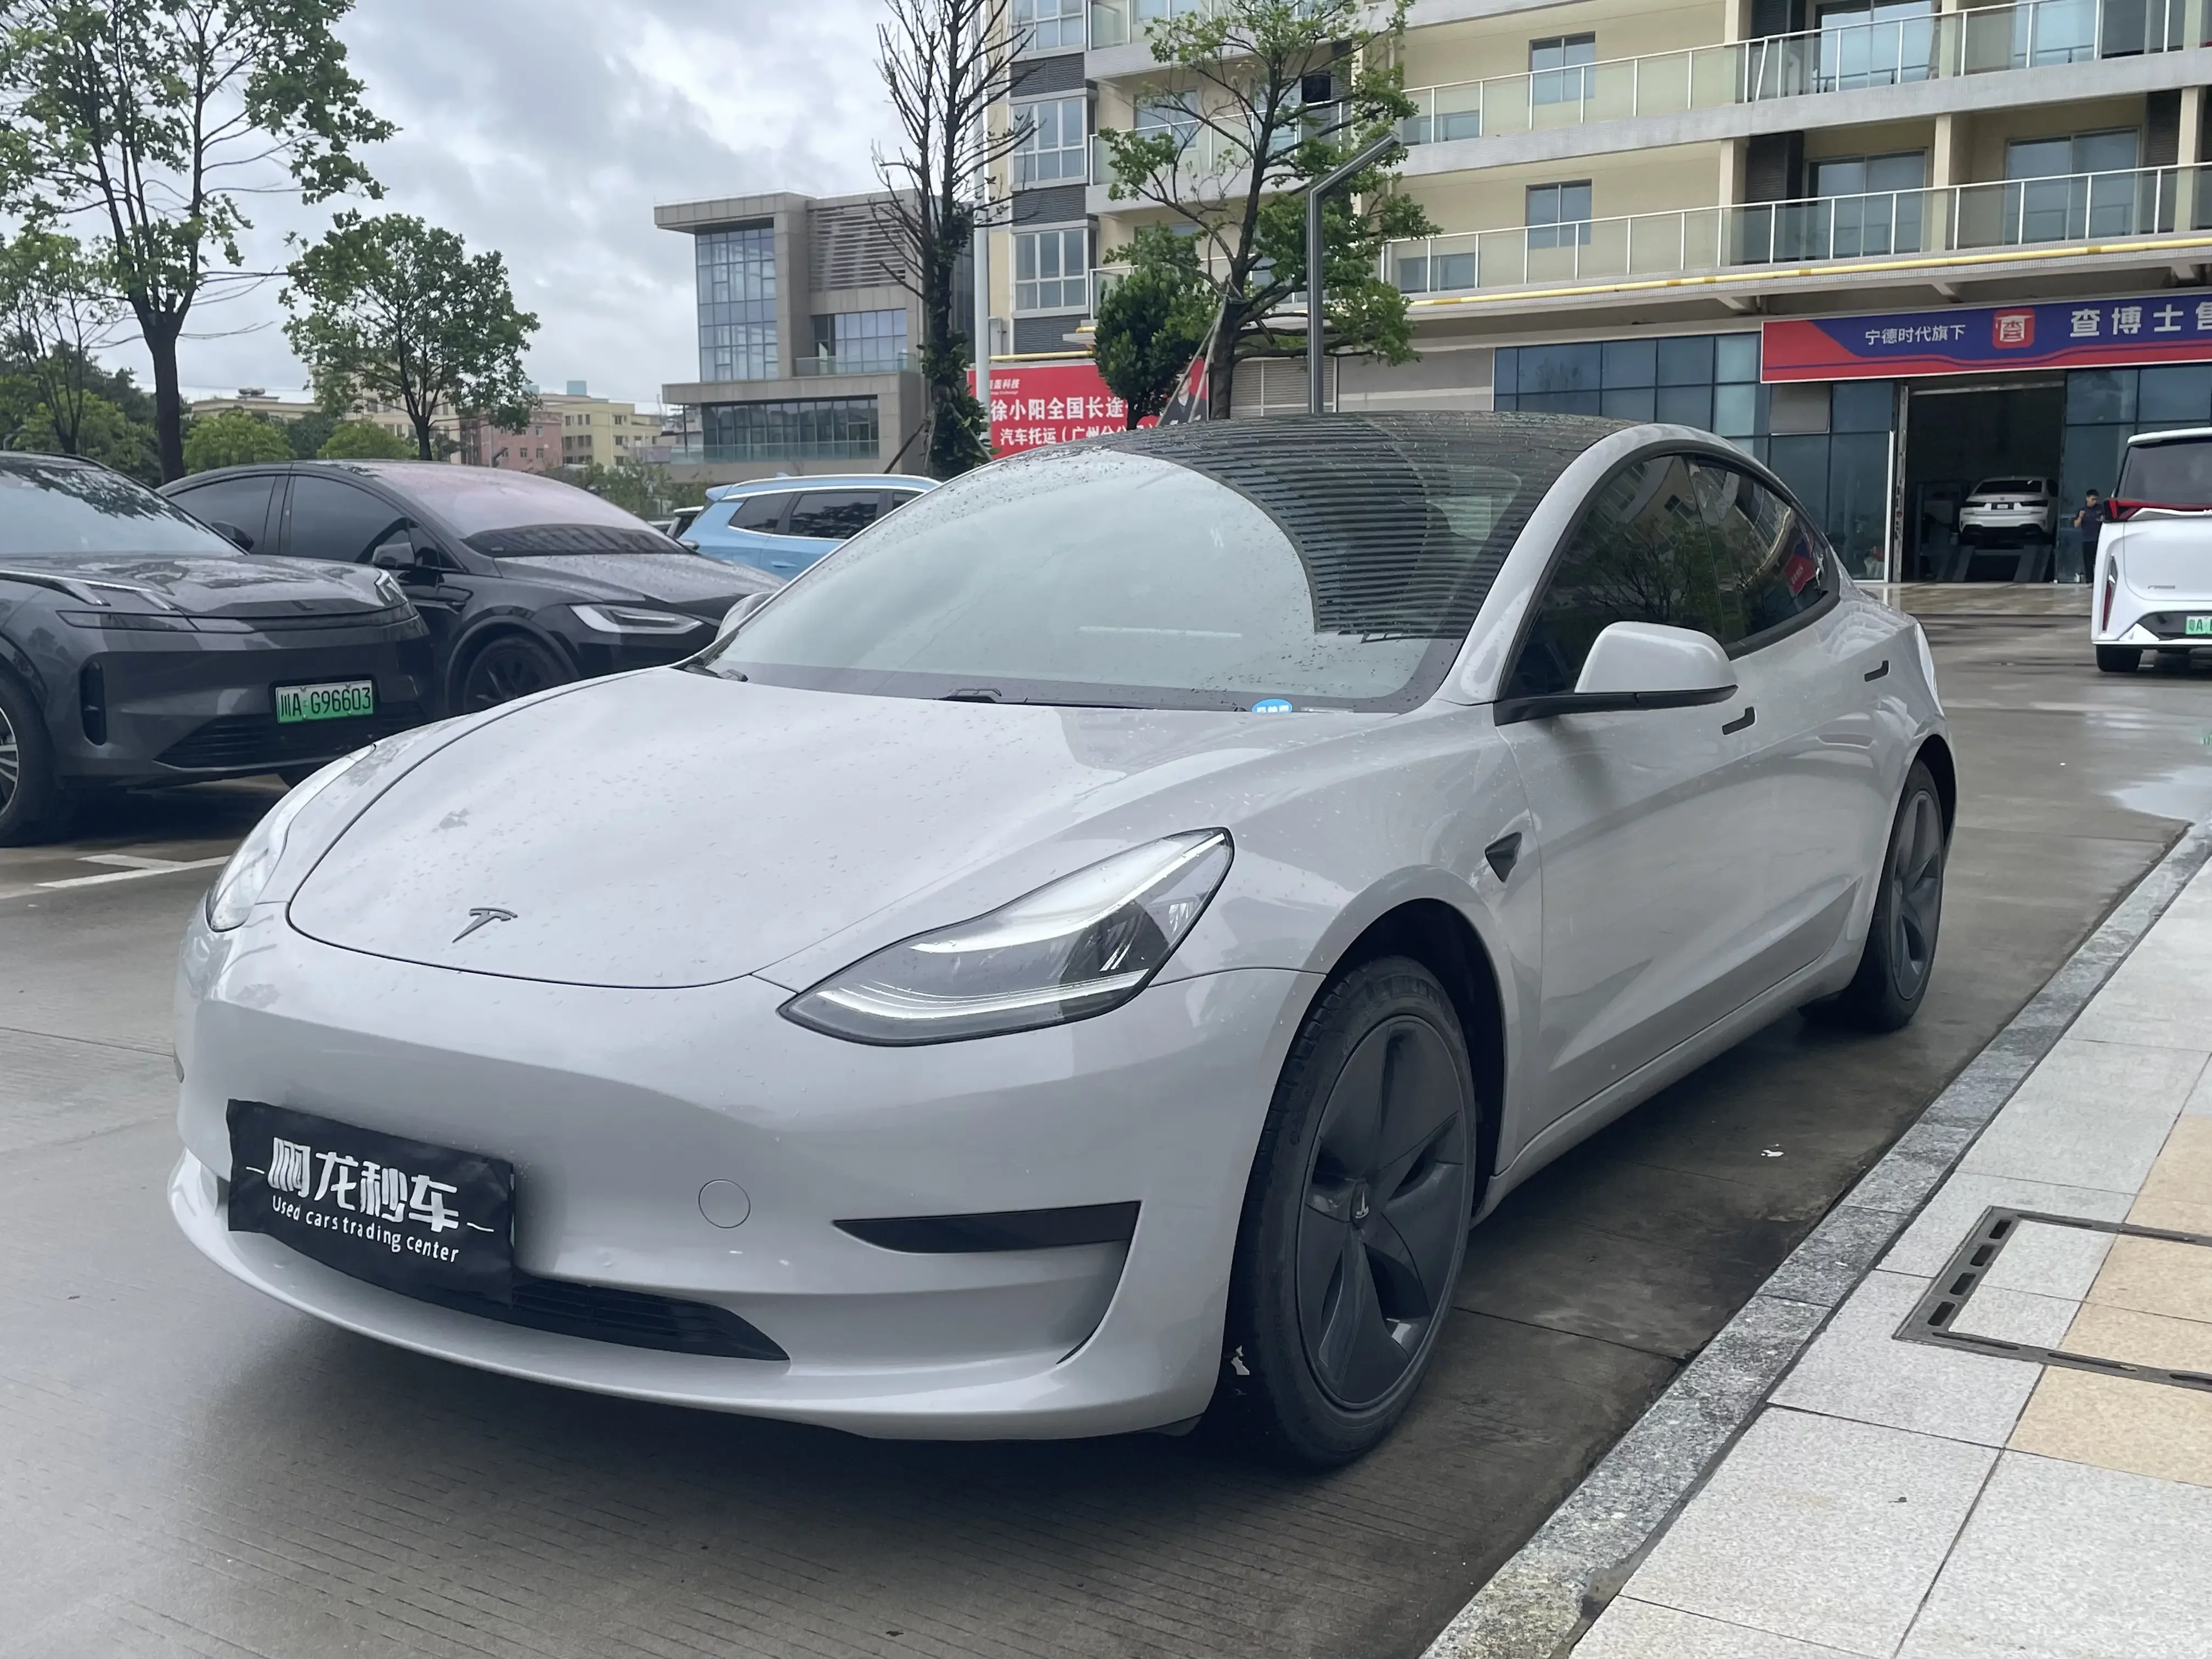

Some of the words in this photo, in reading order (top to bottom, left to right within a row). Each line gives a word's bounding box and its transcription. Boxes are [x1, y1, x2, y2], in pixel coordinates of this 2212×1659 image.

[1865, 325, 1966, 346] 宁德时代旗下
[990, 396, 1128, 422] 徐小阳全国长途
[272, 1195, 301, 1221] Used
[306, 1210, 338, 1231] cars
[342, 1216, 402, 1253] trading
[406, 1235, 459, 1263] center
